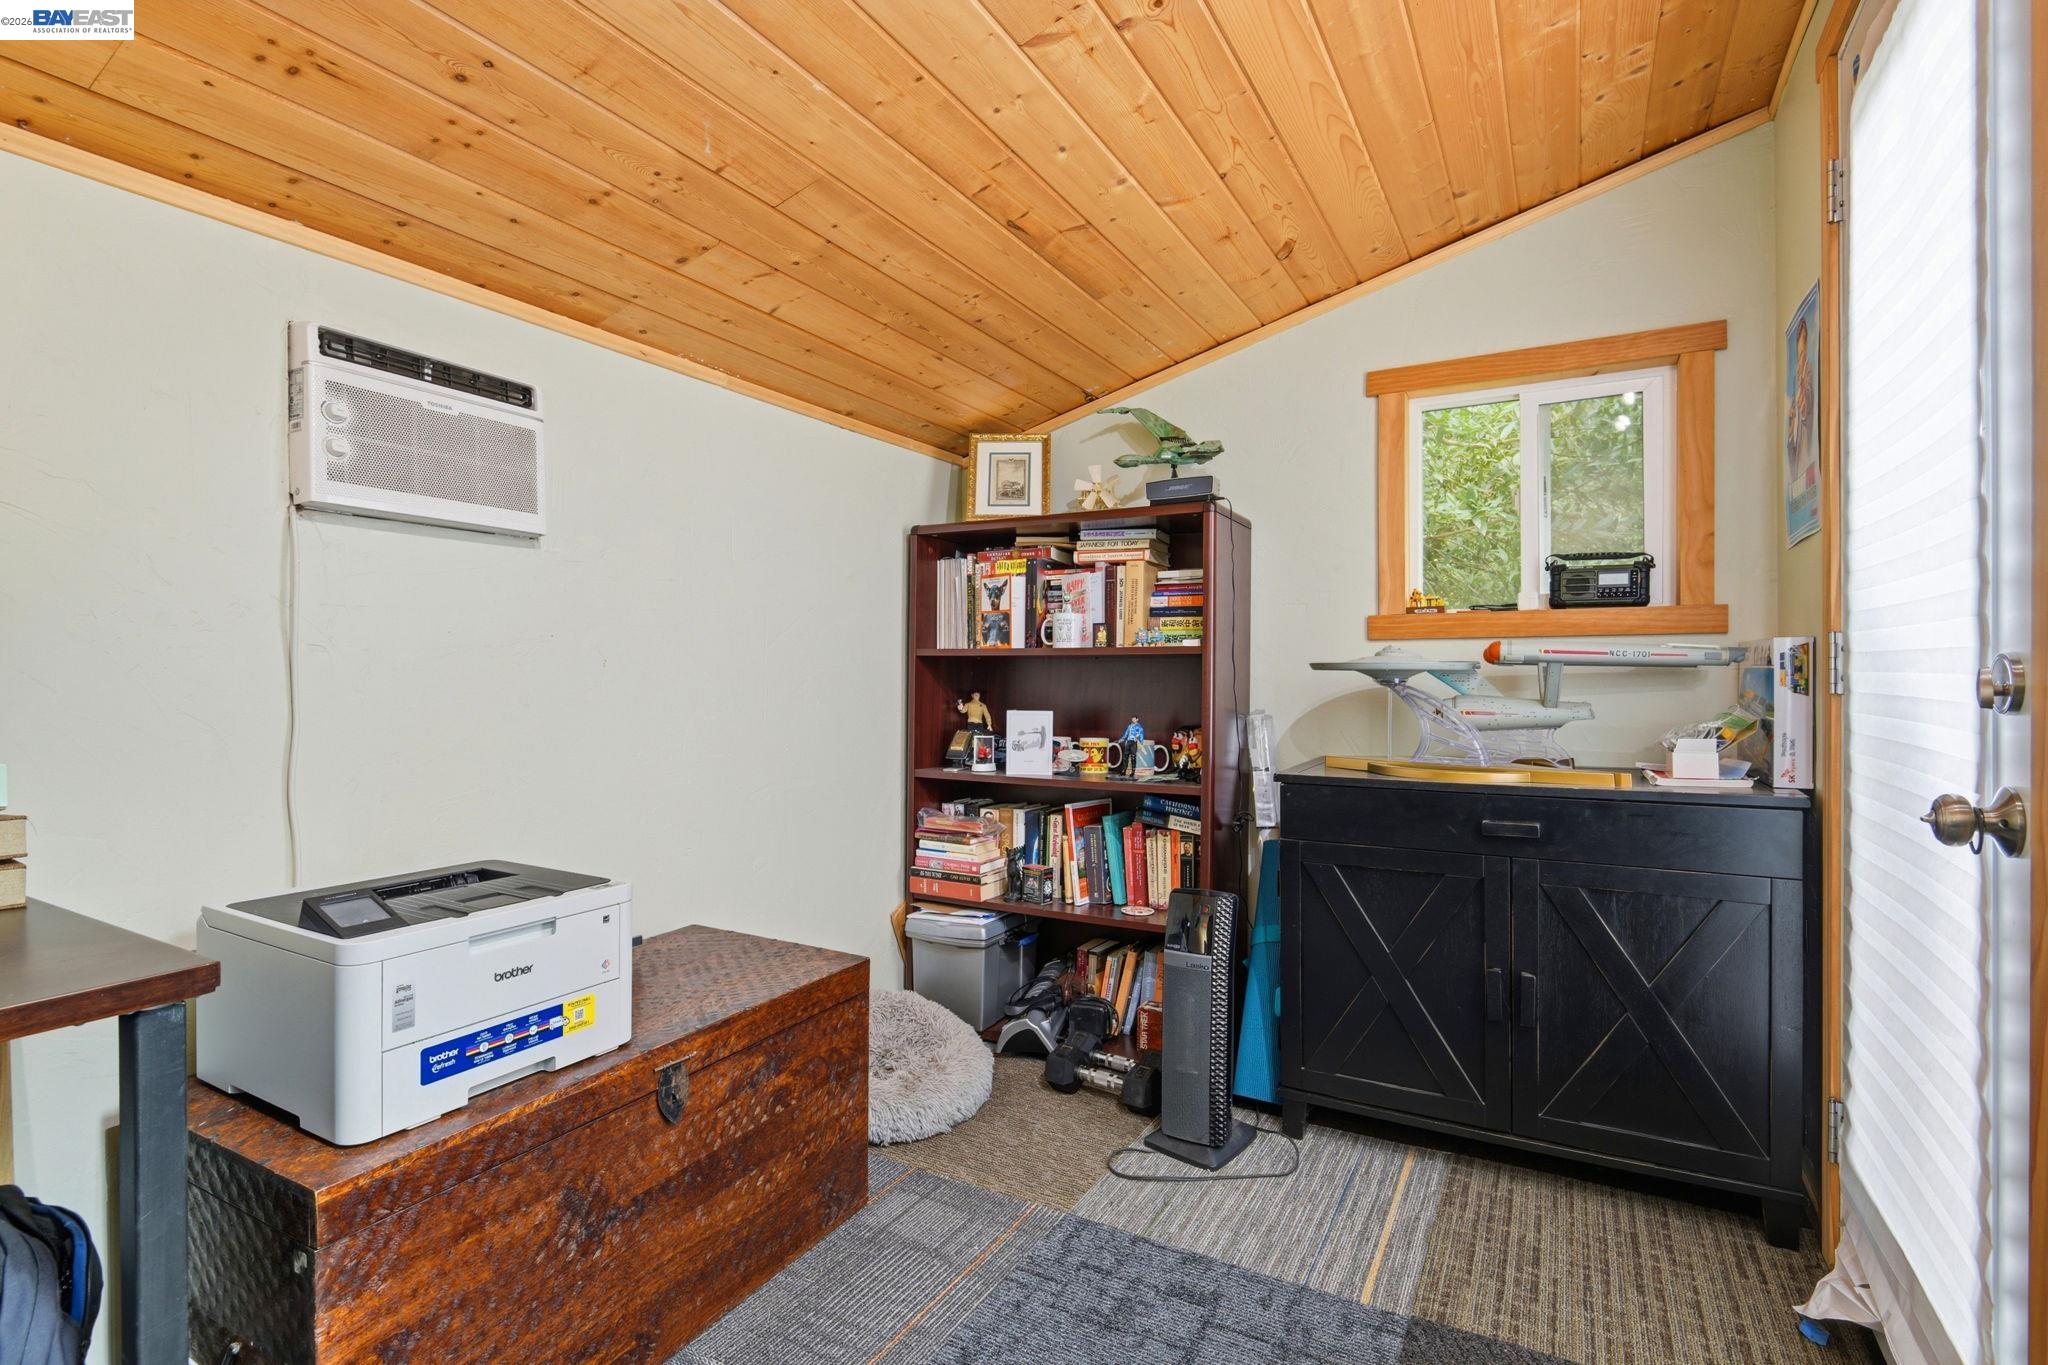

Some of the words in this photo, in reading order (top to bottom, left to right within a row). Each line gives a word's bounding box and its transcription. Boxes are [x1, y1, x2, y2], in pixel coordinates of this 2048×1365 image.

[1789, 774, 1795, 783] SK
[1160, 799, 1200, 812] CALIFORNIA
[1166, 806, 1193, 816] HIKING
[494, 964, 533, 982] brother
[429, 1048, 459, 1063] brother
